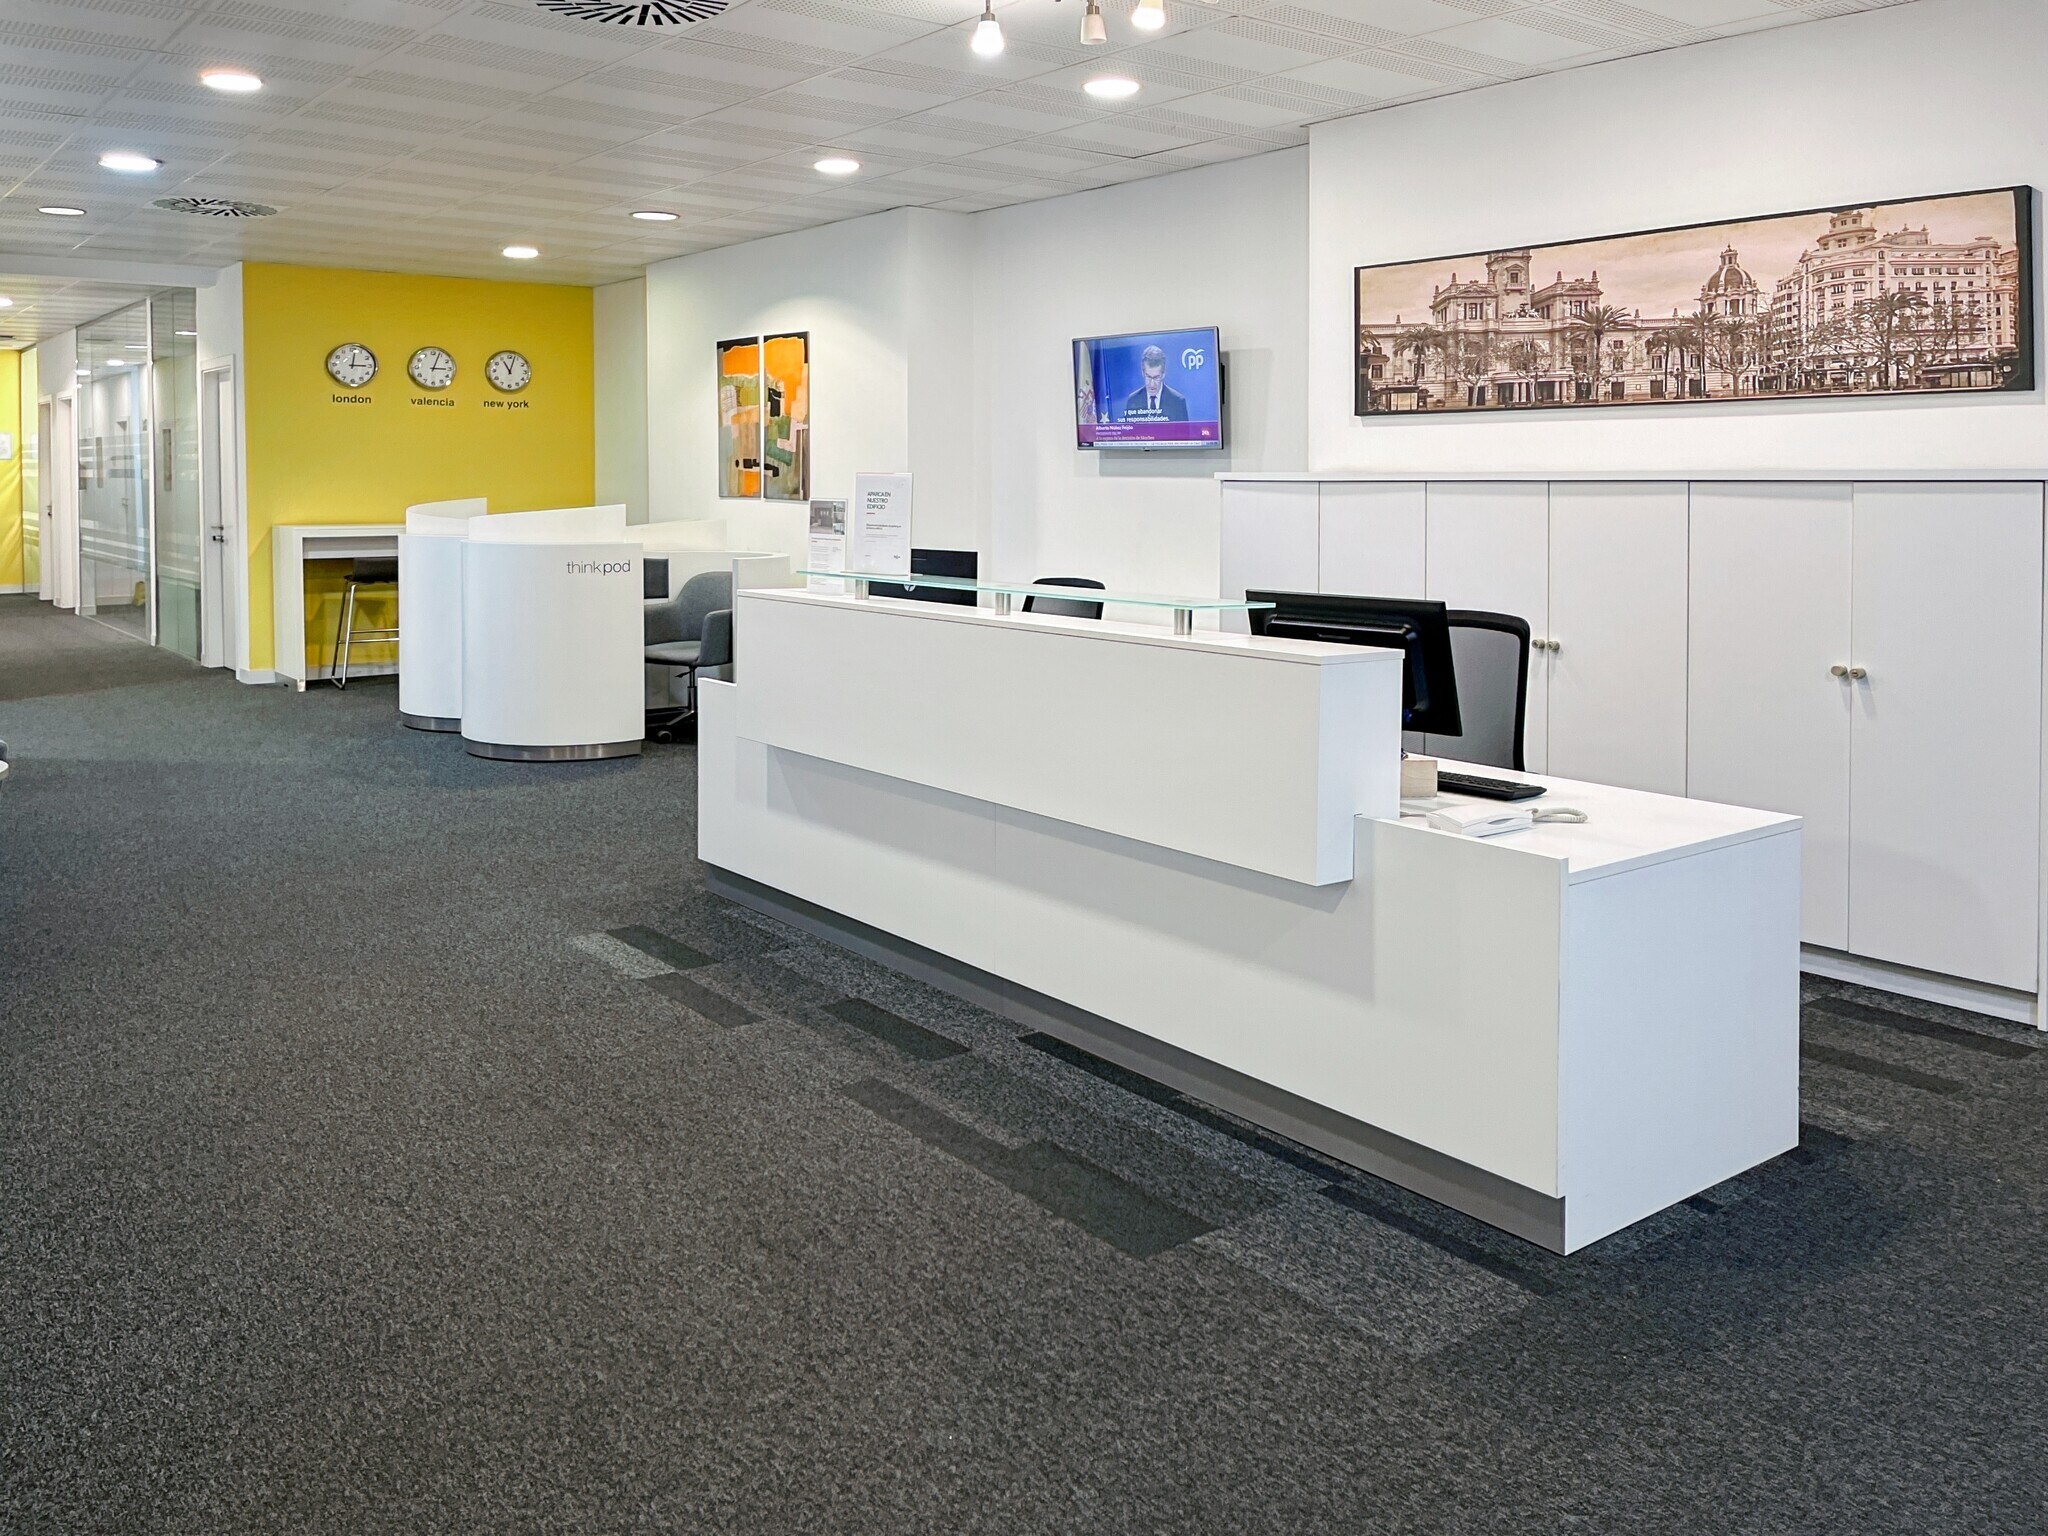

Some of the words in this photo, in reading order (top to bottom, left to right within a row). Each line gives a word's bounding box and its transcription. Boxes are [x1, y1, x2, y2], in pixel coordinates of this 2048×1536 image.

[332, 394, 372, 404] london
[410, 397, 455, 407] valencia
[483, 400, 504, 408] new
[507, 400, 529, 410] york
